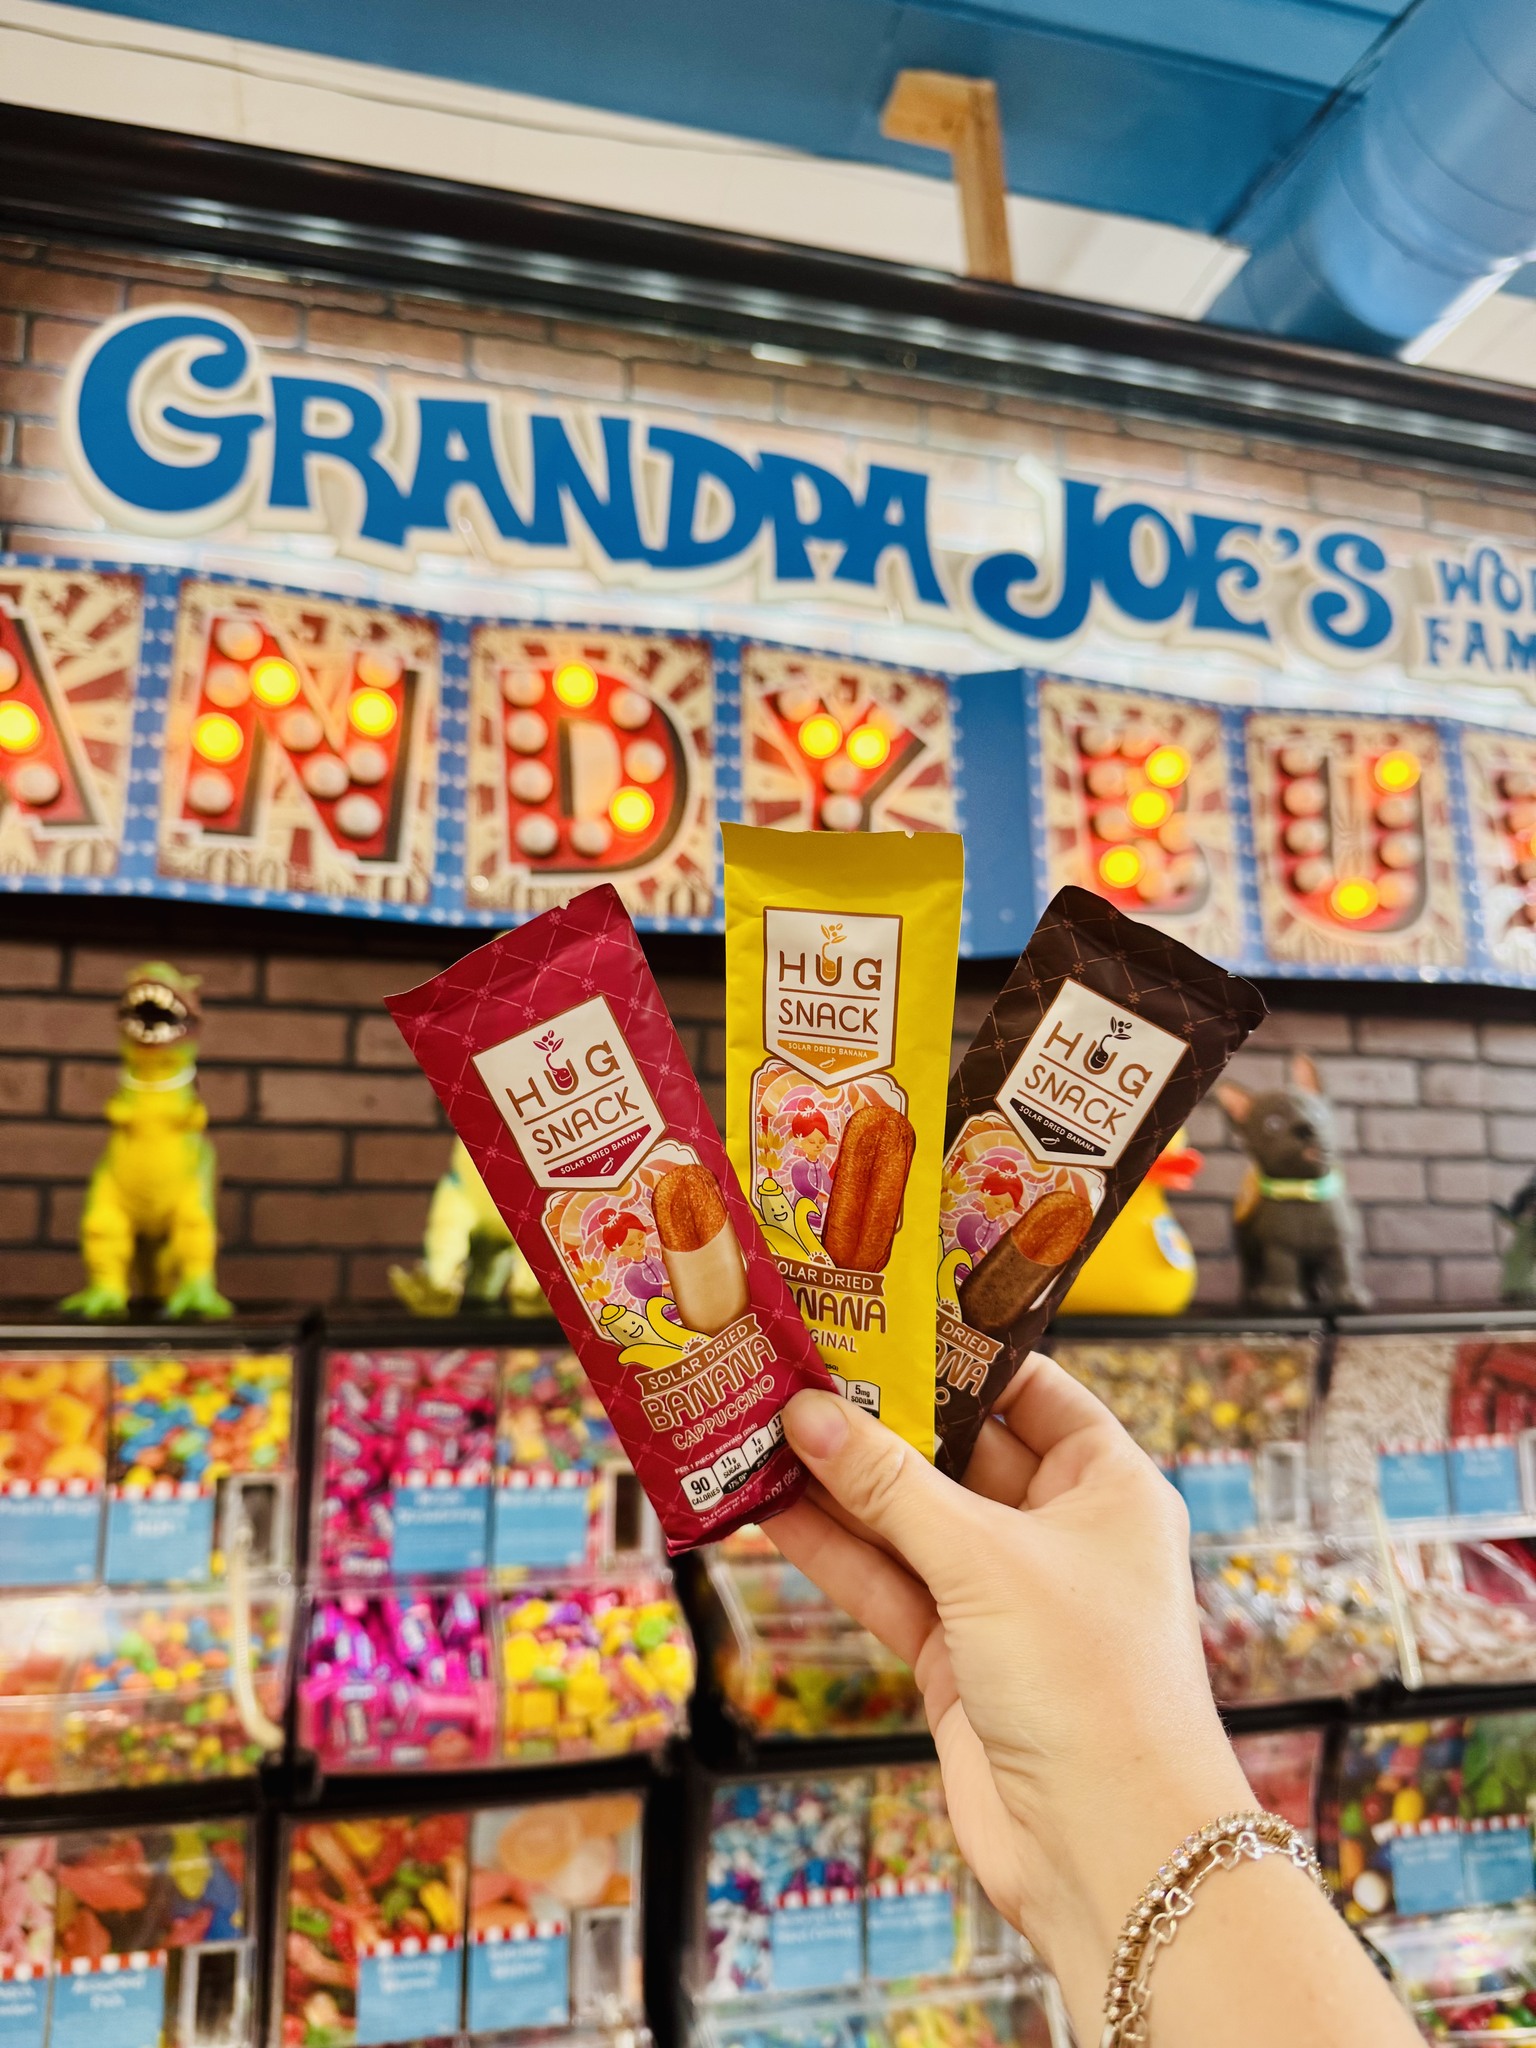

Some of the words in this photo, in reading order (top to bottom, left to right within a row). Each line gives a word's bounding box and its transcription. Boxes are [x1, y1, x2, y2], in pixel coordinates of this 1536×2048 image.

[78, 315, 949, 608] GRANDPA
[972, 478, 1393, 650] JOE'S
[1436, 547, 1536, 615] WO
[779, 950, 882, 991] HUG
[778, 998, 878, 1035] SNACK
[788, 1042, 812, 1051] SOLAR
[813, 1045, 836, 1055] DRIED
[838, 1048, 868, 1058] BANANA
[1043, 1020, 1153, 1099] HUG
[505, 1040, 621, 1118] HUG
[1024, 1064, 1126, 1136] SNACK
[531, 1086, 640, 1155] SNACK
[1019, 1105, 1042, 1123] SOLAR
[1043, 1118, 1066, 1136] DRIED
[1066, 1132, 1095, 1153] BANANA
[560, 1160, 586, 1175] SOLAR
[586, 1148, 610, 1163] DRIED
[611, 1131, 642, 1150] BANANA
[776, 1261, 818, 1282] OLAR
[823, 1272, 874, 1291] DRIED
[792, 1286, 886, 1334] NANA
[648, 1357, 702, 1390] SOLAR
[704, 1325, 748, 1367] DRIED
[810, 1329, 857, 1353] GINAL
[941, 1321, 990, 1354] DRIED
[640, 1334, 777, 1432] BANANA
[851, 1395, 874, 1405] SODIUM
[672, 1374, 775, 1450] CAPPUCCINO
[675, 1464, 690, 1475] PER
[695, 1452, 715, 1466] PIECE
[715, 1434, 742, 1454] SERVING
[723, 1463, 742, 1478] SUGAR
[690, 1476, 711, 1495] 90
[692, 1487, 721, 1506] CALORIES
